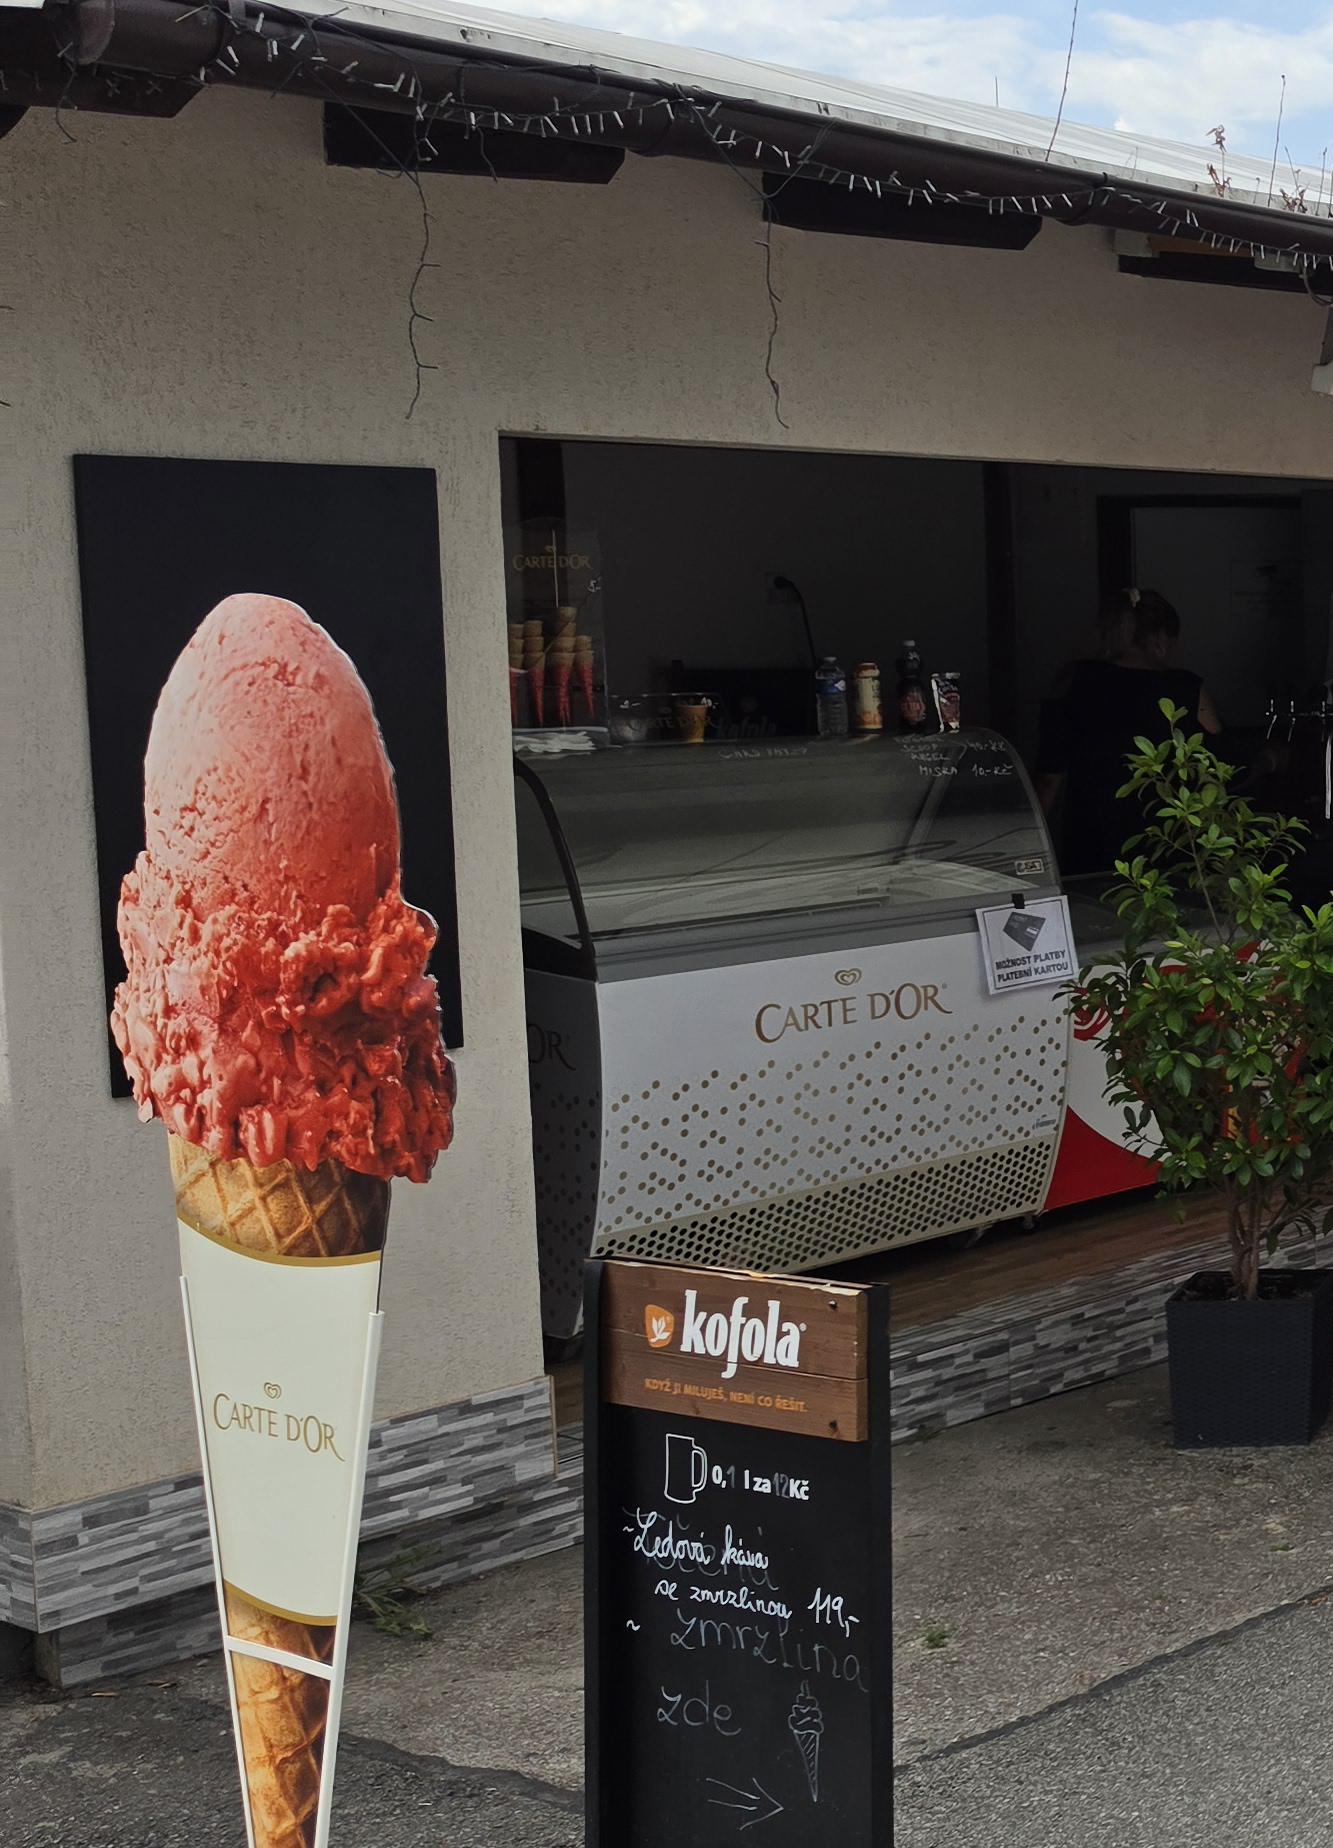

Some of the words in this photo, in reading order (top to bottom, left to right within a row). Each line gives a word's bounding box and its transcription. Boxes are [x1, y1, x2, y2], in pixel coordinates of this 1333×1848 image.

[1033, 949, 1066, 963] PLATBY
[1034, 962, 1069, 976] KARTOU
[755, 996, 857, 1045] CARTE
[869, 982, 953, 1021] D'OR
[680, 1289, 801, 1379] kofola
[644, 1377, 671, 1392] KDYŽ
[729, 1391, 755, 1405] NENÍ
[757, 1395, 773, 1407] CO
[213, 1393, 279, 1437] CARTE
[285, 1414, 346, 1462] D'OR
[633, 1507, 711, 1565] Ledová
[720, 1524, 769, 1569] káva
[654, 1579, 679, 1601] se
[690, 1586, 793, 1619] zmrzlinou
